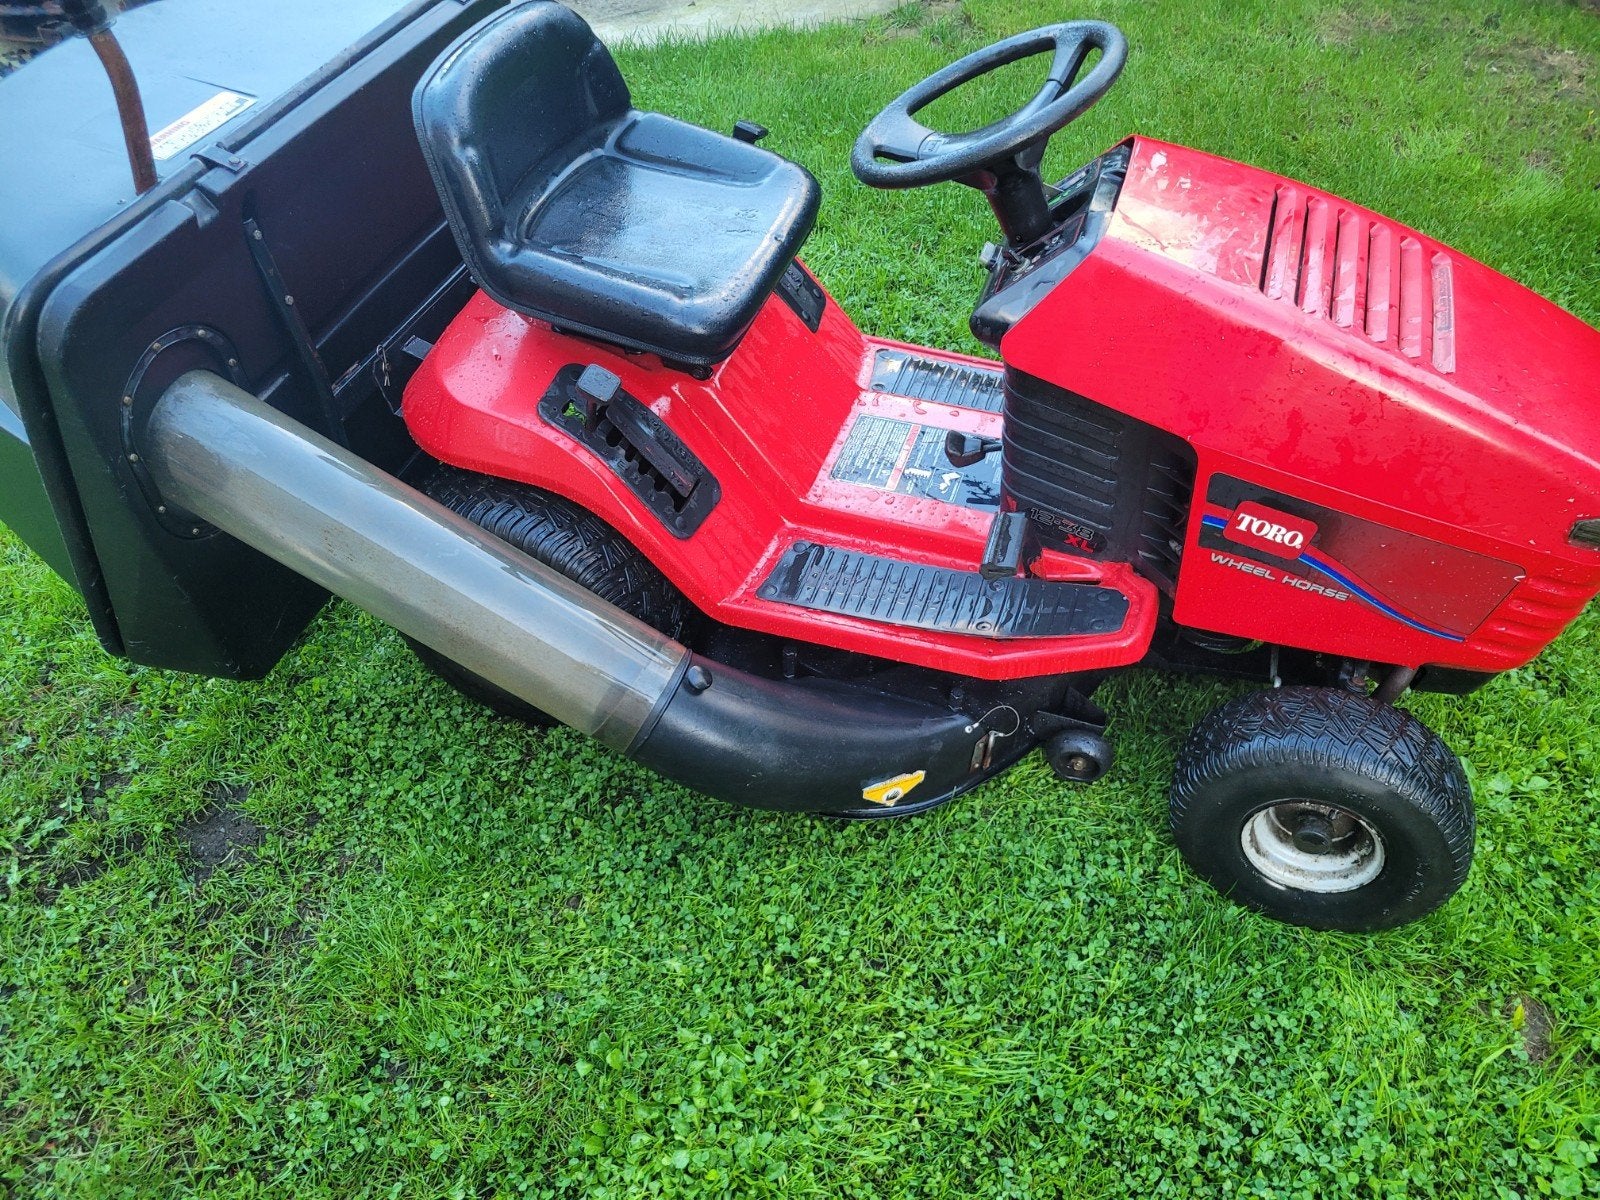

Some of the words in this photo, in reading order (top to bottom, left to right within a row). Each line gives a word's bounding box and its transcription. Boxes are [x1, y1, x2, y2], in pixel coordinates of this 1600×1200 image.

[1064, 533, 1094, 554] XL
[1235, 512, 1304, 549] TORO
[1210, 552, 1276, 581] WHEEL
[1281, 575, 1350, 601] HORSE
